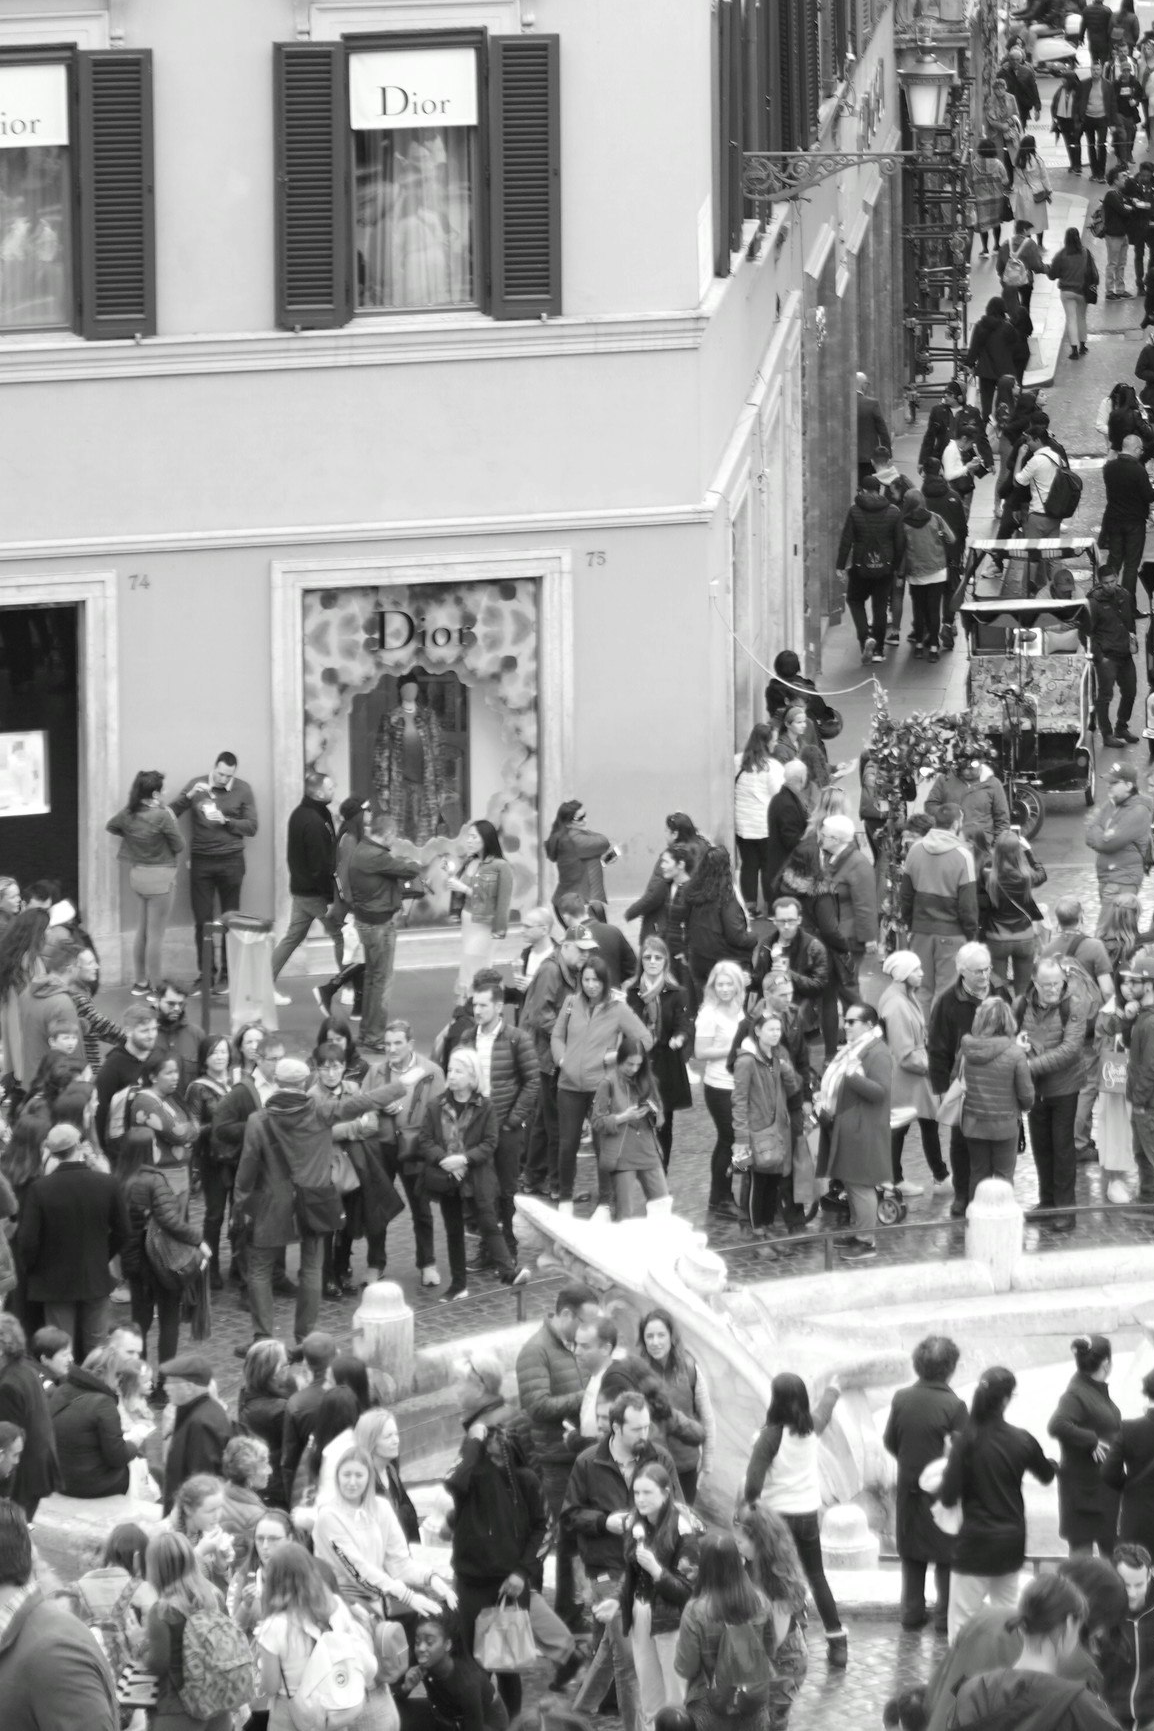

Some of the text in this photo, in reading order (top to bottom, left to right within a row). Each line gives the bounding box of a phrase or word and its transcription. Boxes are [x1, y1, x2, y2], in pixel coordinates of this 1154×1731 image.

[376, 85, 451, 116] Dior
[0, 111, 41, 135] ior
[585, 550, 606, 567] 75
[128, 573, 150, 590] 74
[371, 610, 472, 650] Dior
